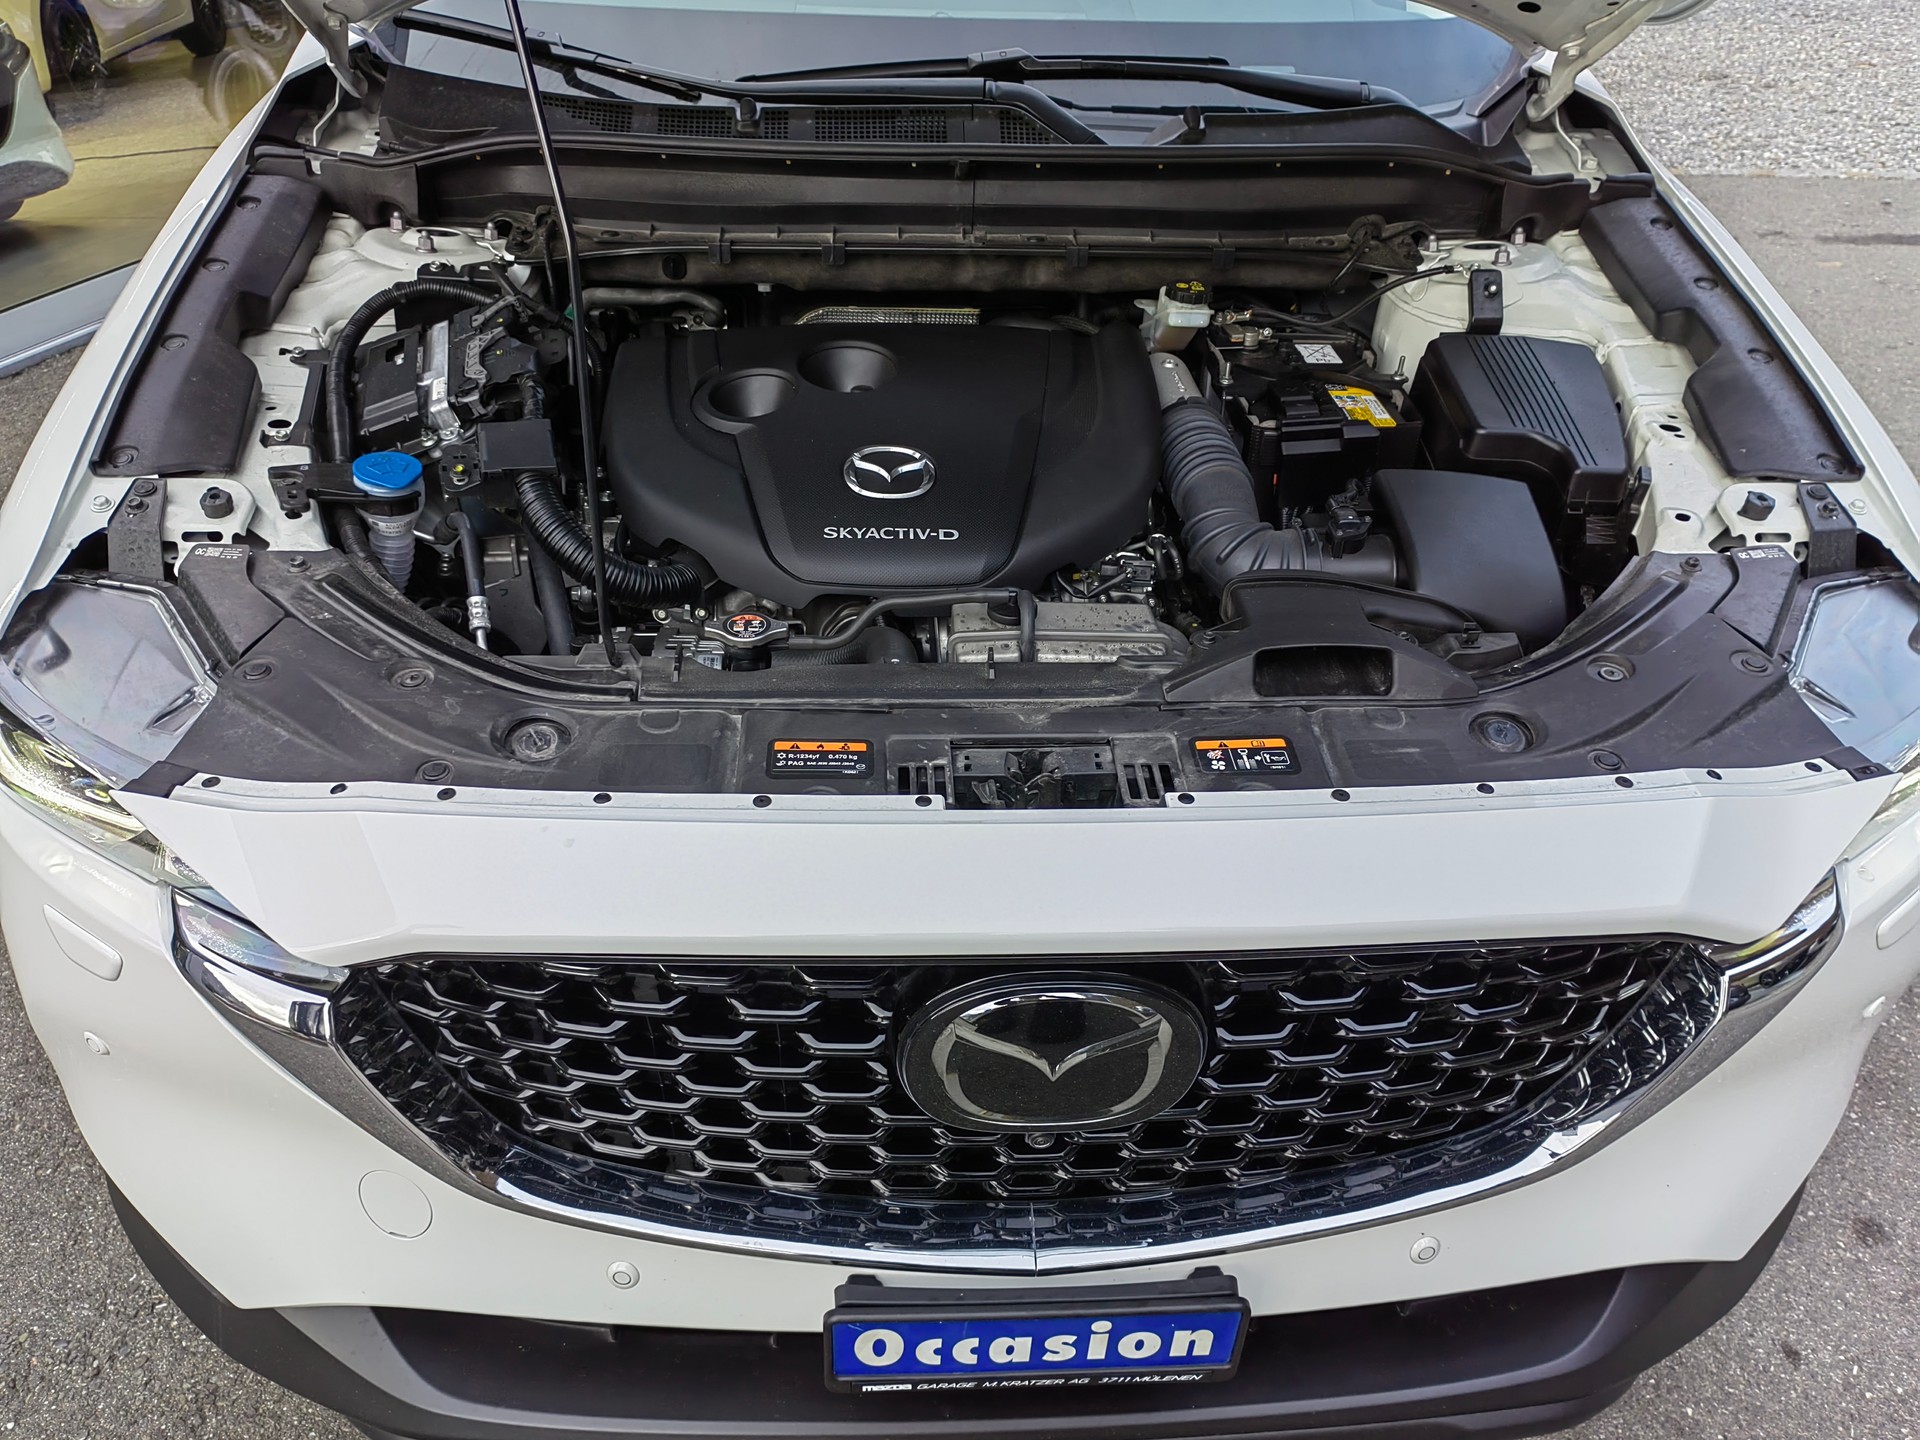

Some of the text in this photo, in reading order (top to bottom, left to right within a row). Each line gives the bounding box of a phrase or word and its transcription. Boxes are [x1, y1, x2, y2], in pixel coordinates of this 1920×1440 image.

[823, 526, 960, 541] SKYACTIV-D
[854, 1320, 1215, 1367] Occasion
[862, 1384, 912, 1392] mazda
[916, 1381, 978, 1390] GARAGE
[1067, 1377, 1091, 1385] AG
[1098, 1376, 1131, 1384] 3711
[1131, 1374, 1204, 1383] MÜLENEN
